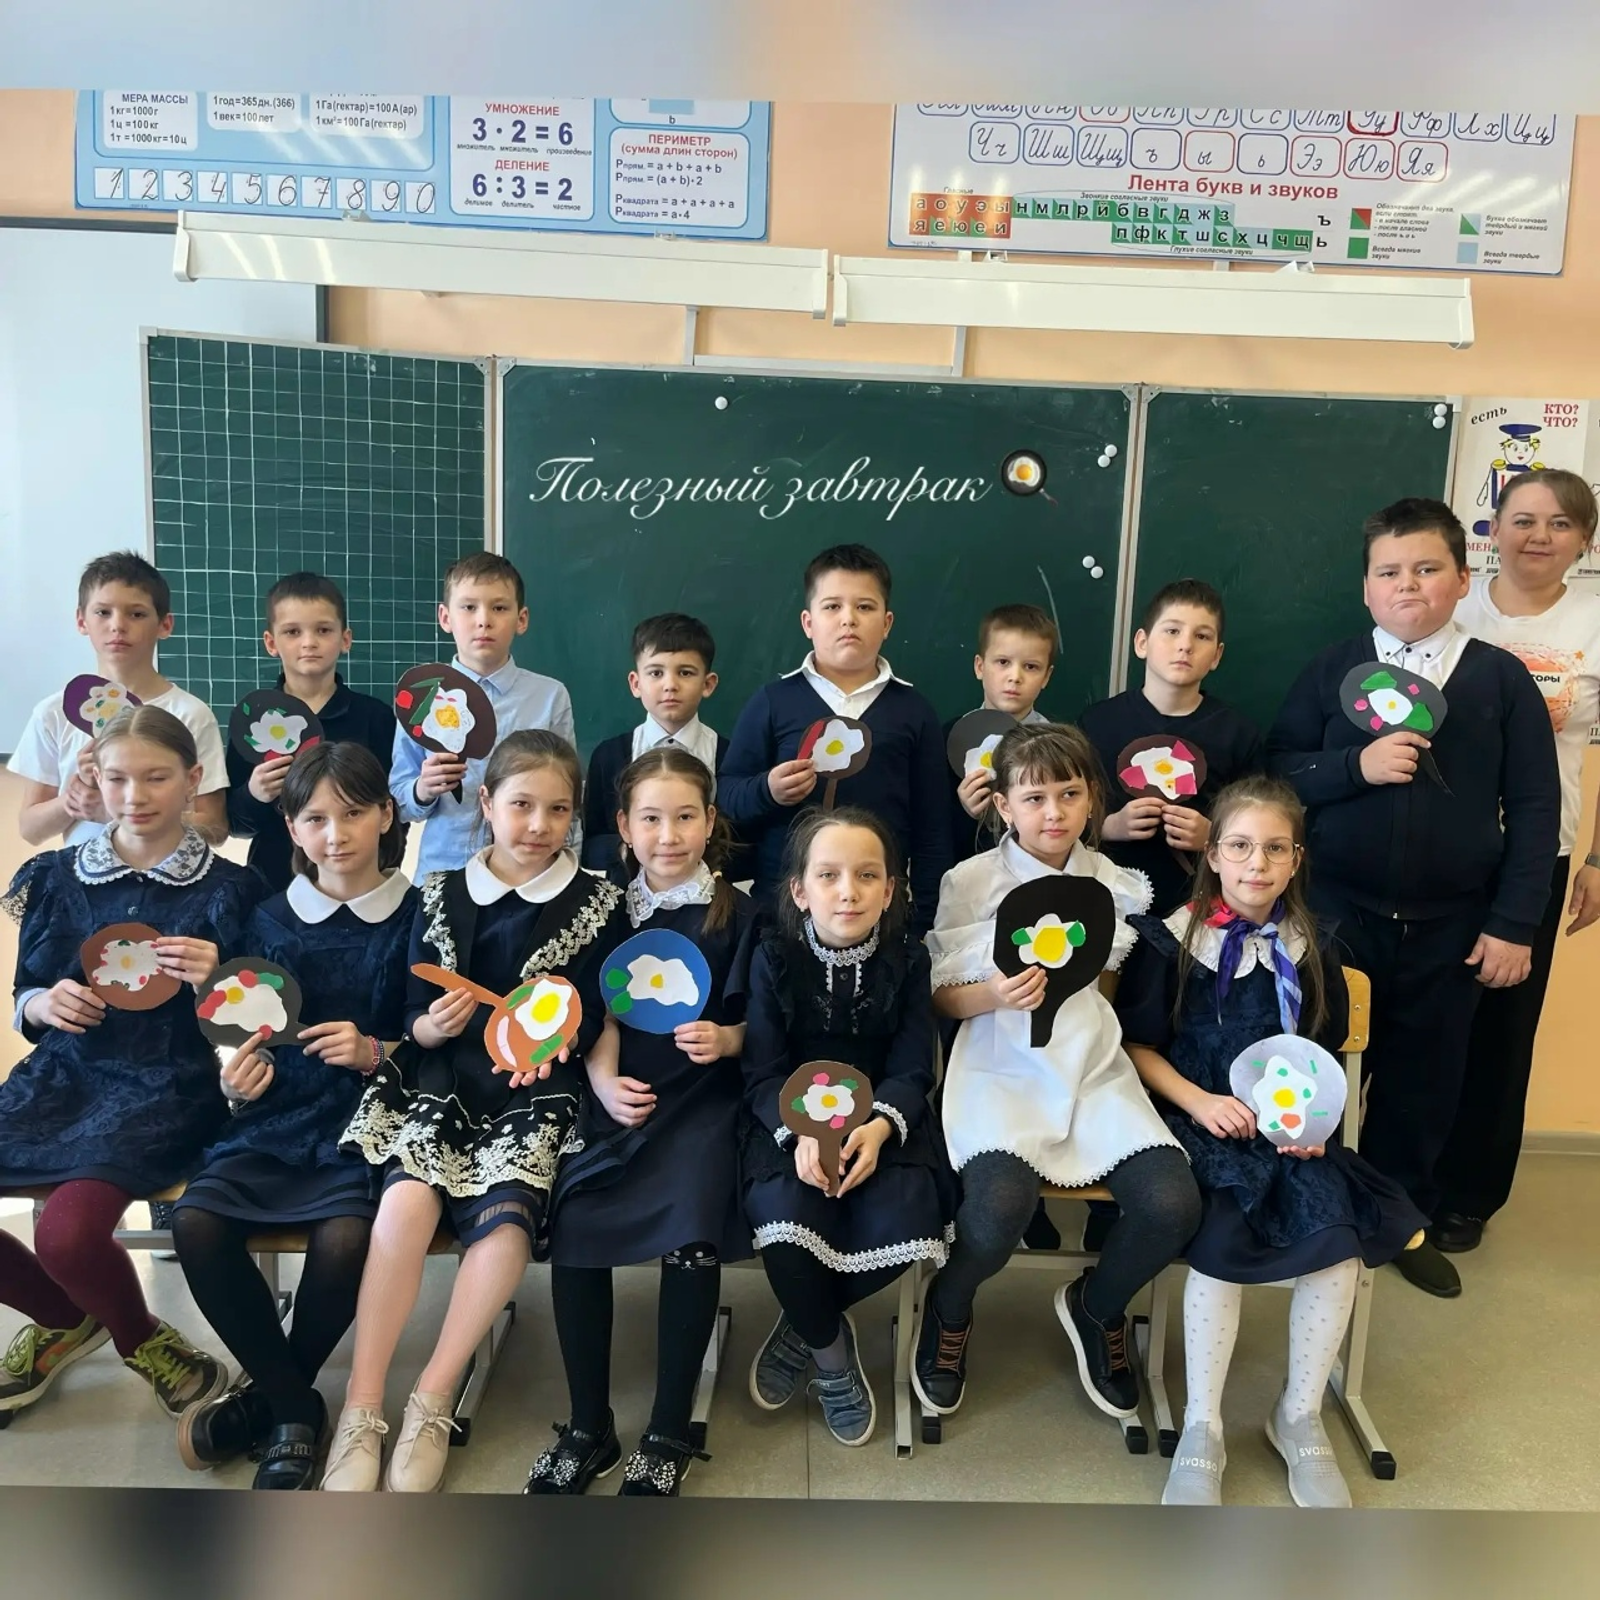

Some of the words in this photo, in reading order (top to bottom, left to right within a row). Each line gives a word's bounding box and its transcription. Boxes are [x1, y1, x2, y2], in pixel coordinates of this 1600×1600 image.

[122, 94, 148, 103] МЕРА
[151, 94, 189, 104] МАССЫ
[485, 103, 560, 116] УМНОЖЕНИЕ
[669, 115, 676, 125] b
[472, 118, 487, 142] 3
[511, 120, 526, 144] 2
[558, 122, 573, 146] 6
[648, 134, 712, 146] ПЕРИМЕТР
[621, 143, 660, 155] (сумма
[663, 147, 692, 156] длин
[694, 148, 738, 160] сторон)
[495, 160, 550, 172] ДЕЛЕНИЕ
[111, 168, 124, 198] 1
[142, 169, 158, 200] 2
[175, 171, 193, 201] 3
[211, 172, 227, 203] 4
[244, 173, 262, 204] 5
[278, 175, 297, 206] 6
[314, 176, 331, 208] 7
[348, 178, 366, 210] 8
[382, 180, 400, 212] 9
[417, 182, 435, 214] 0
[472, 174, 487, 197] 6
[511, 175, 526, 199] 3
[558, 178, 573, 201] 2
[1128, 174, 1189, 192] Лента
[1196, 178, 1243, 197] букв
[1250, 184, 1261, 195] и
[1268, 184, 1338, 201] звуков
[1471, 407, 1508, 425] есть
[1544, 404, 1579, 415] КТО?
[1543, 416, 1578, 428] ЧТО?
